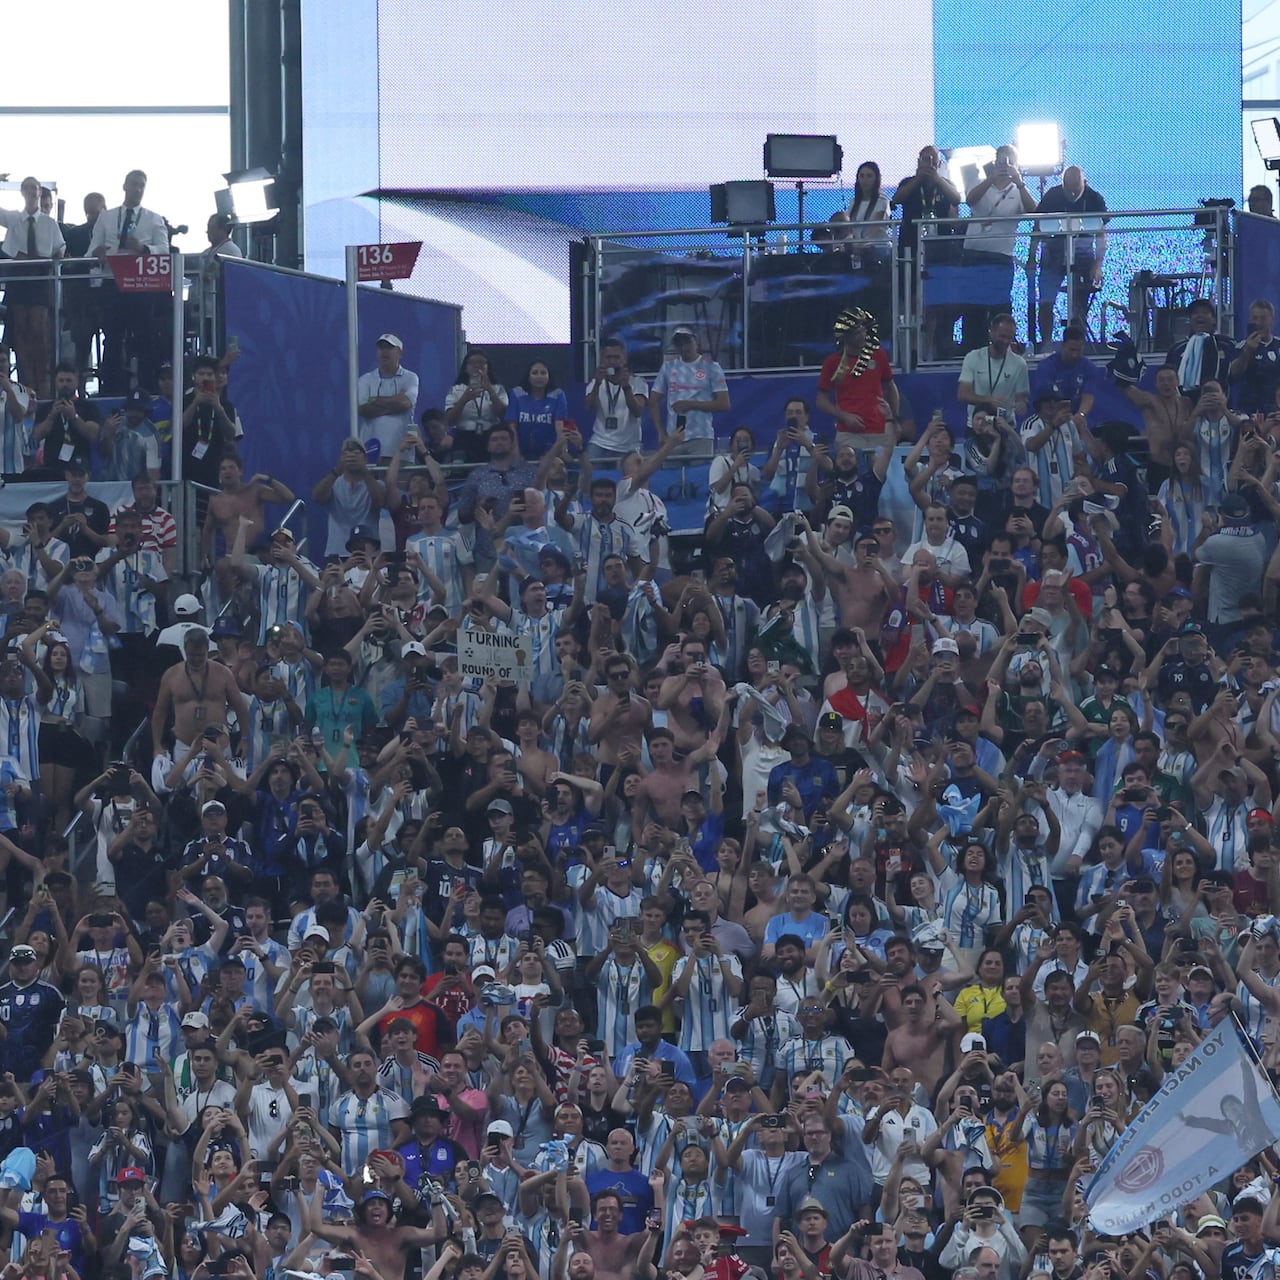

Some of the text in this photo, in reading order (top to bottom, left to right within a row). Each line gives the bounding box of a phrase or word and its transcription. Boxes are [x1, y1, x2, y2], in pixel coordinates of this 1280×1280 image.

[358, 246, 394, 266] 136
[135, 256, 170, 275] 135
[465, 632, 520, 650] TURNING
[498, 667, 512, 678] OF
[1120, 817, 1129, 833] 9
[438, 880, 451, 898] 10
